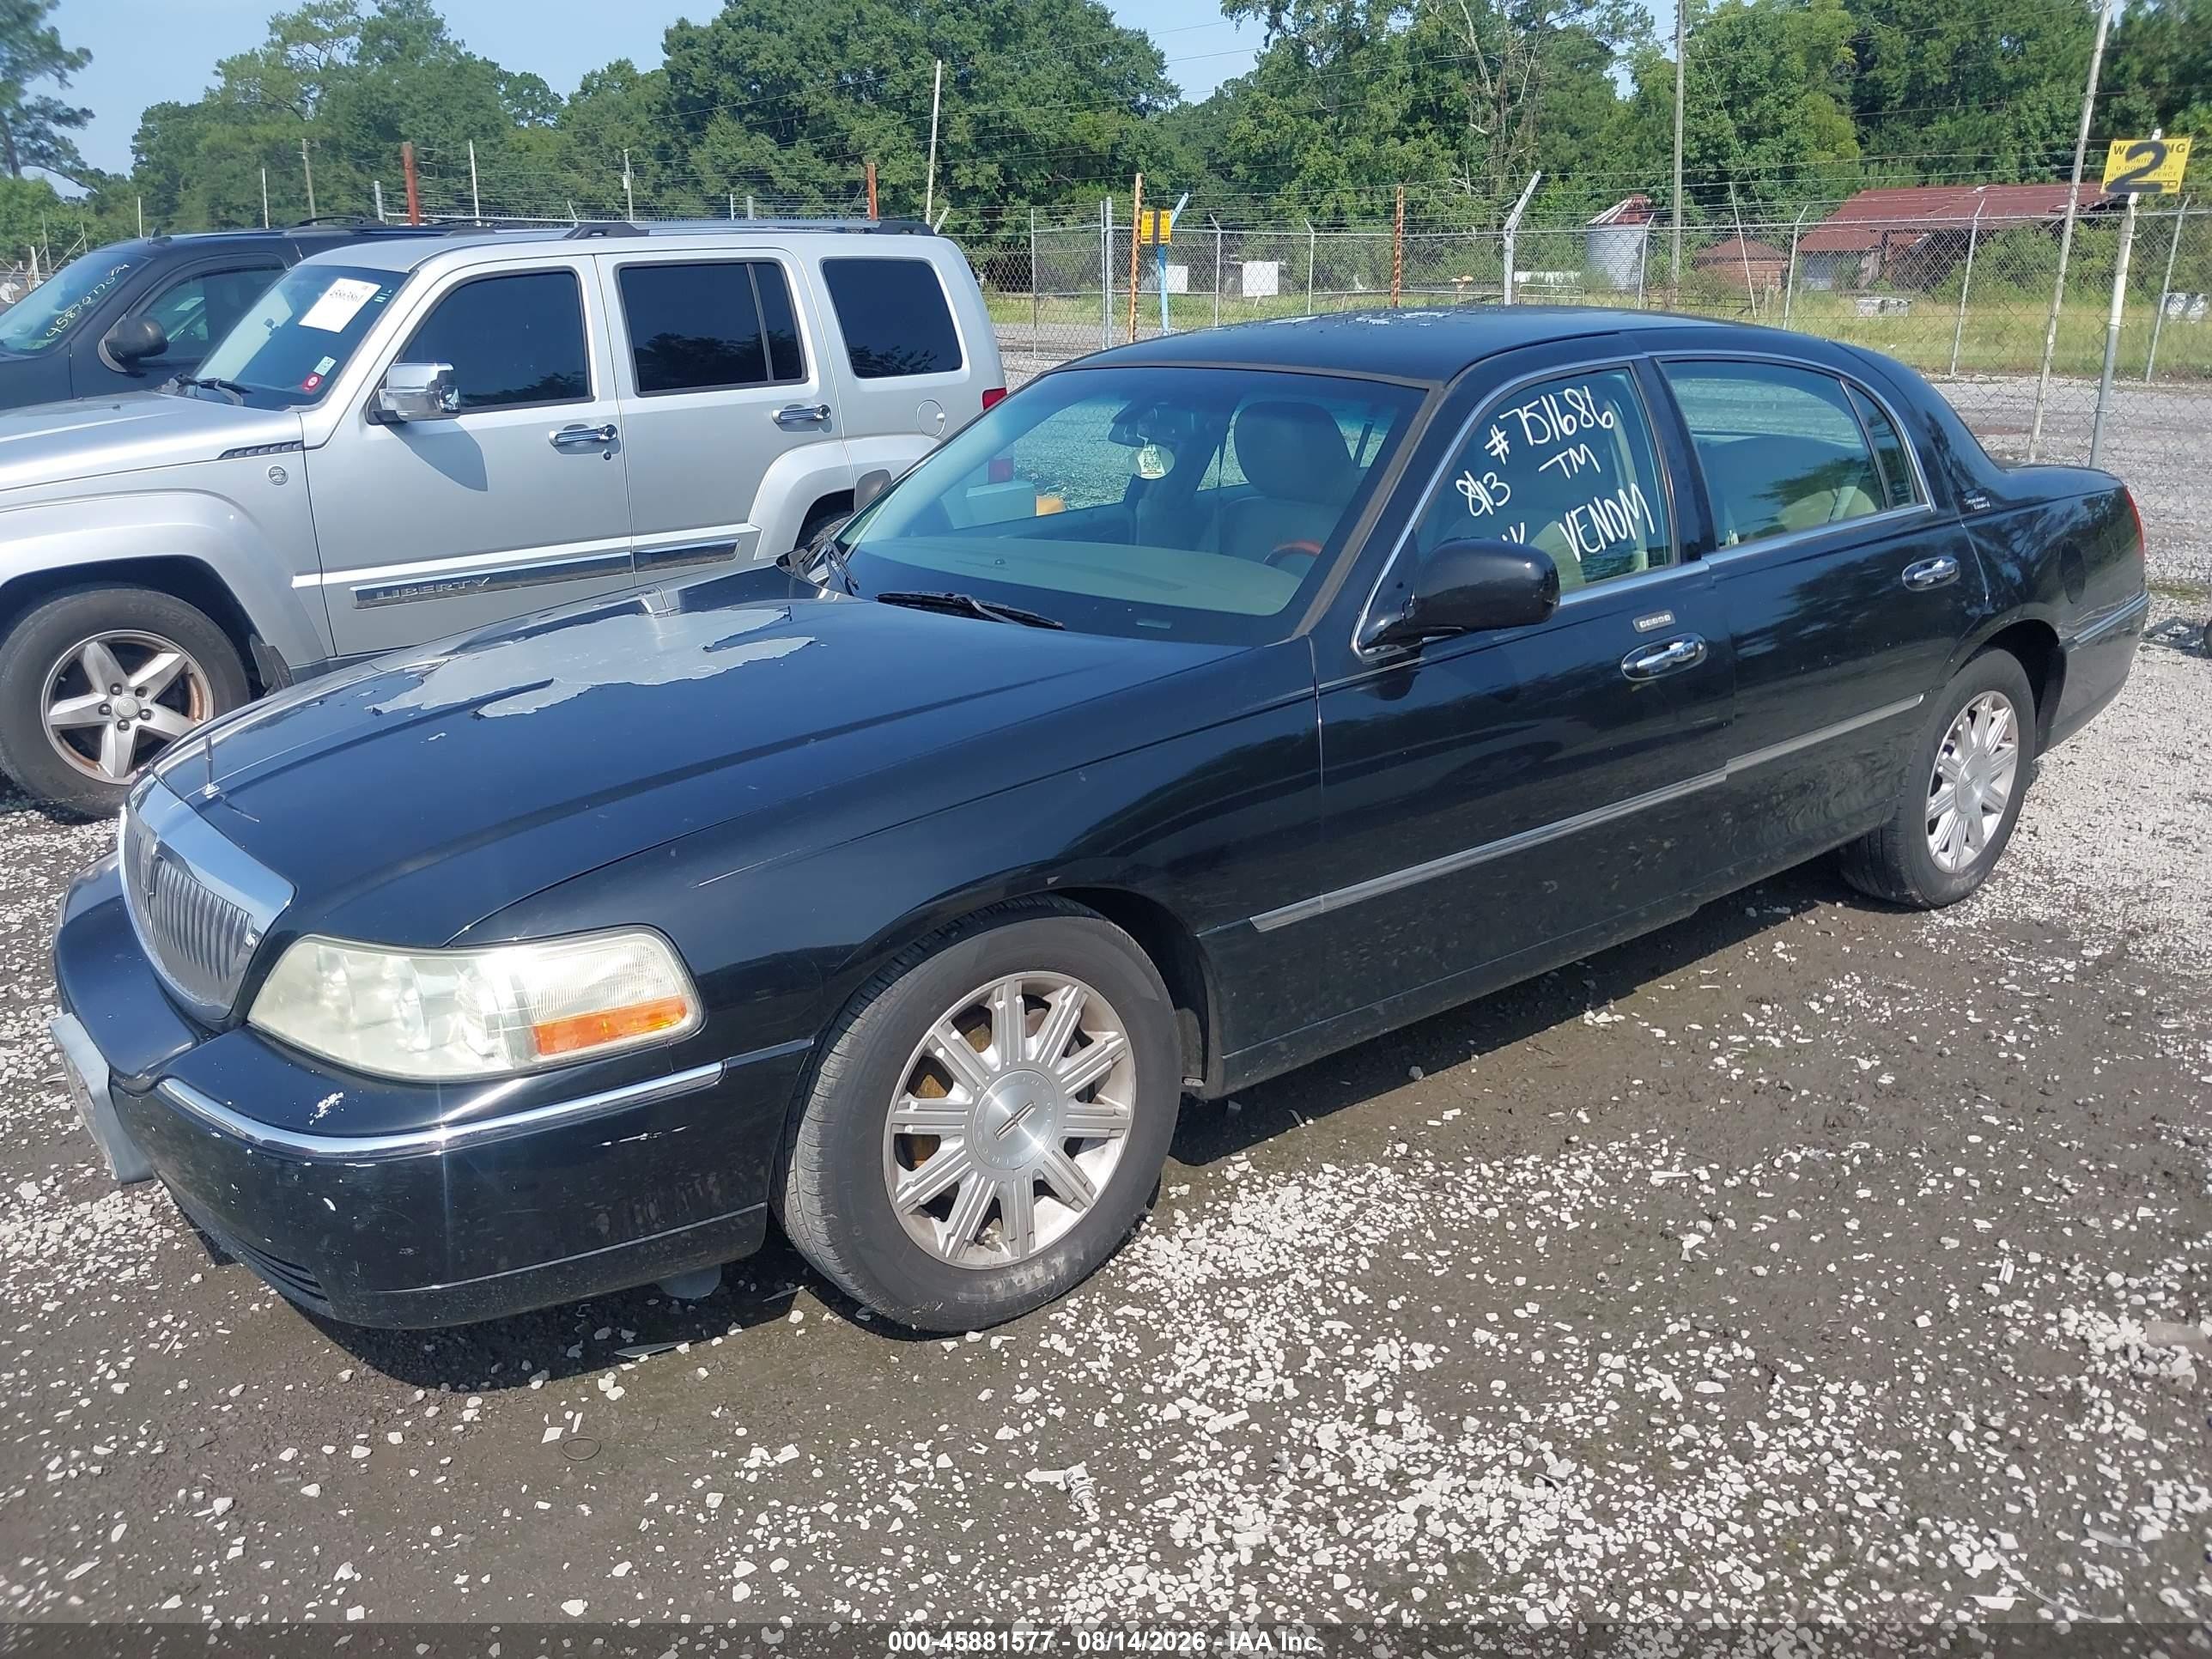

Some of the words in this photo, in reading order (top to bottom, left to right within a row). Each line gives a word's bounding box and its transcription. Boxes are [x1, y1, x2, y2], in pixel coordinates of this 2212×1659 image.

[2106, 141, 2167, 193] 2
[1538, 443, 1601, 480] TM
[1558, 483, 1656, 563] VENOM
[376, 576, 490, 599] LIBERTY
